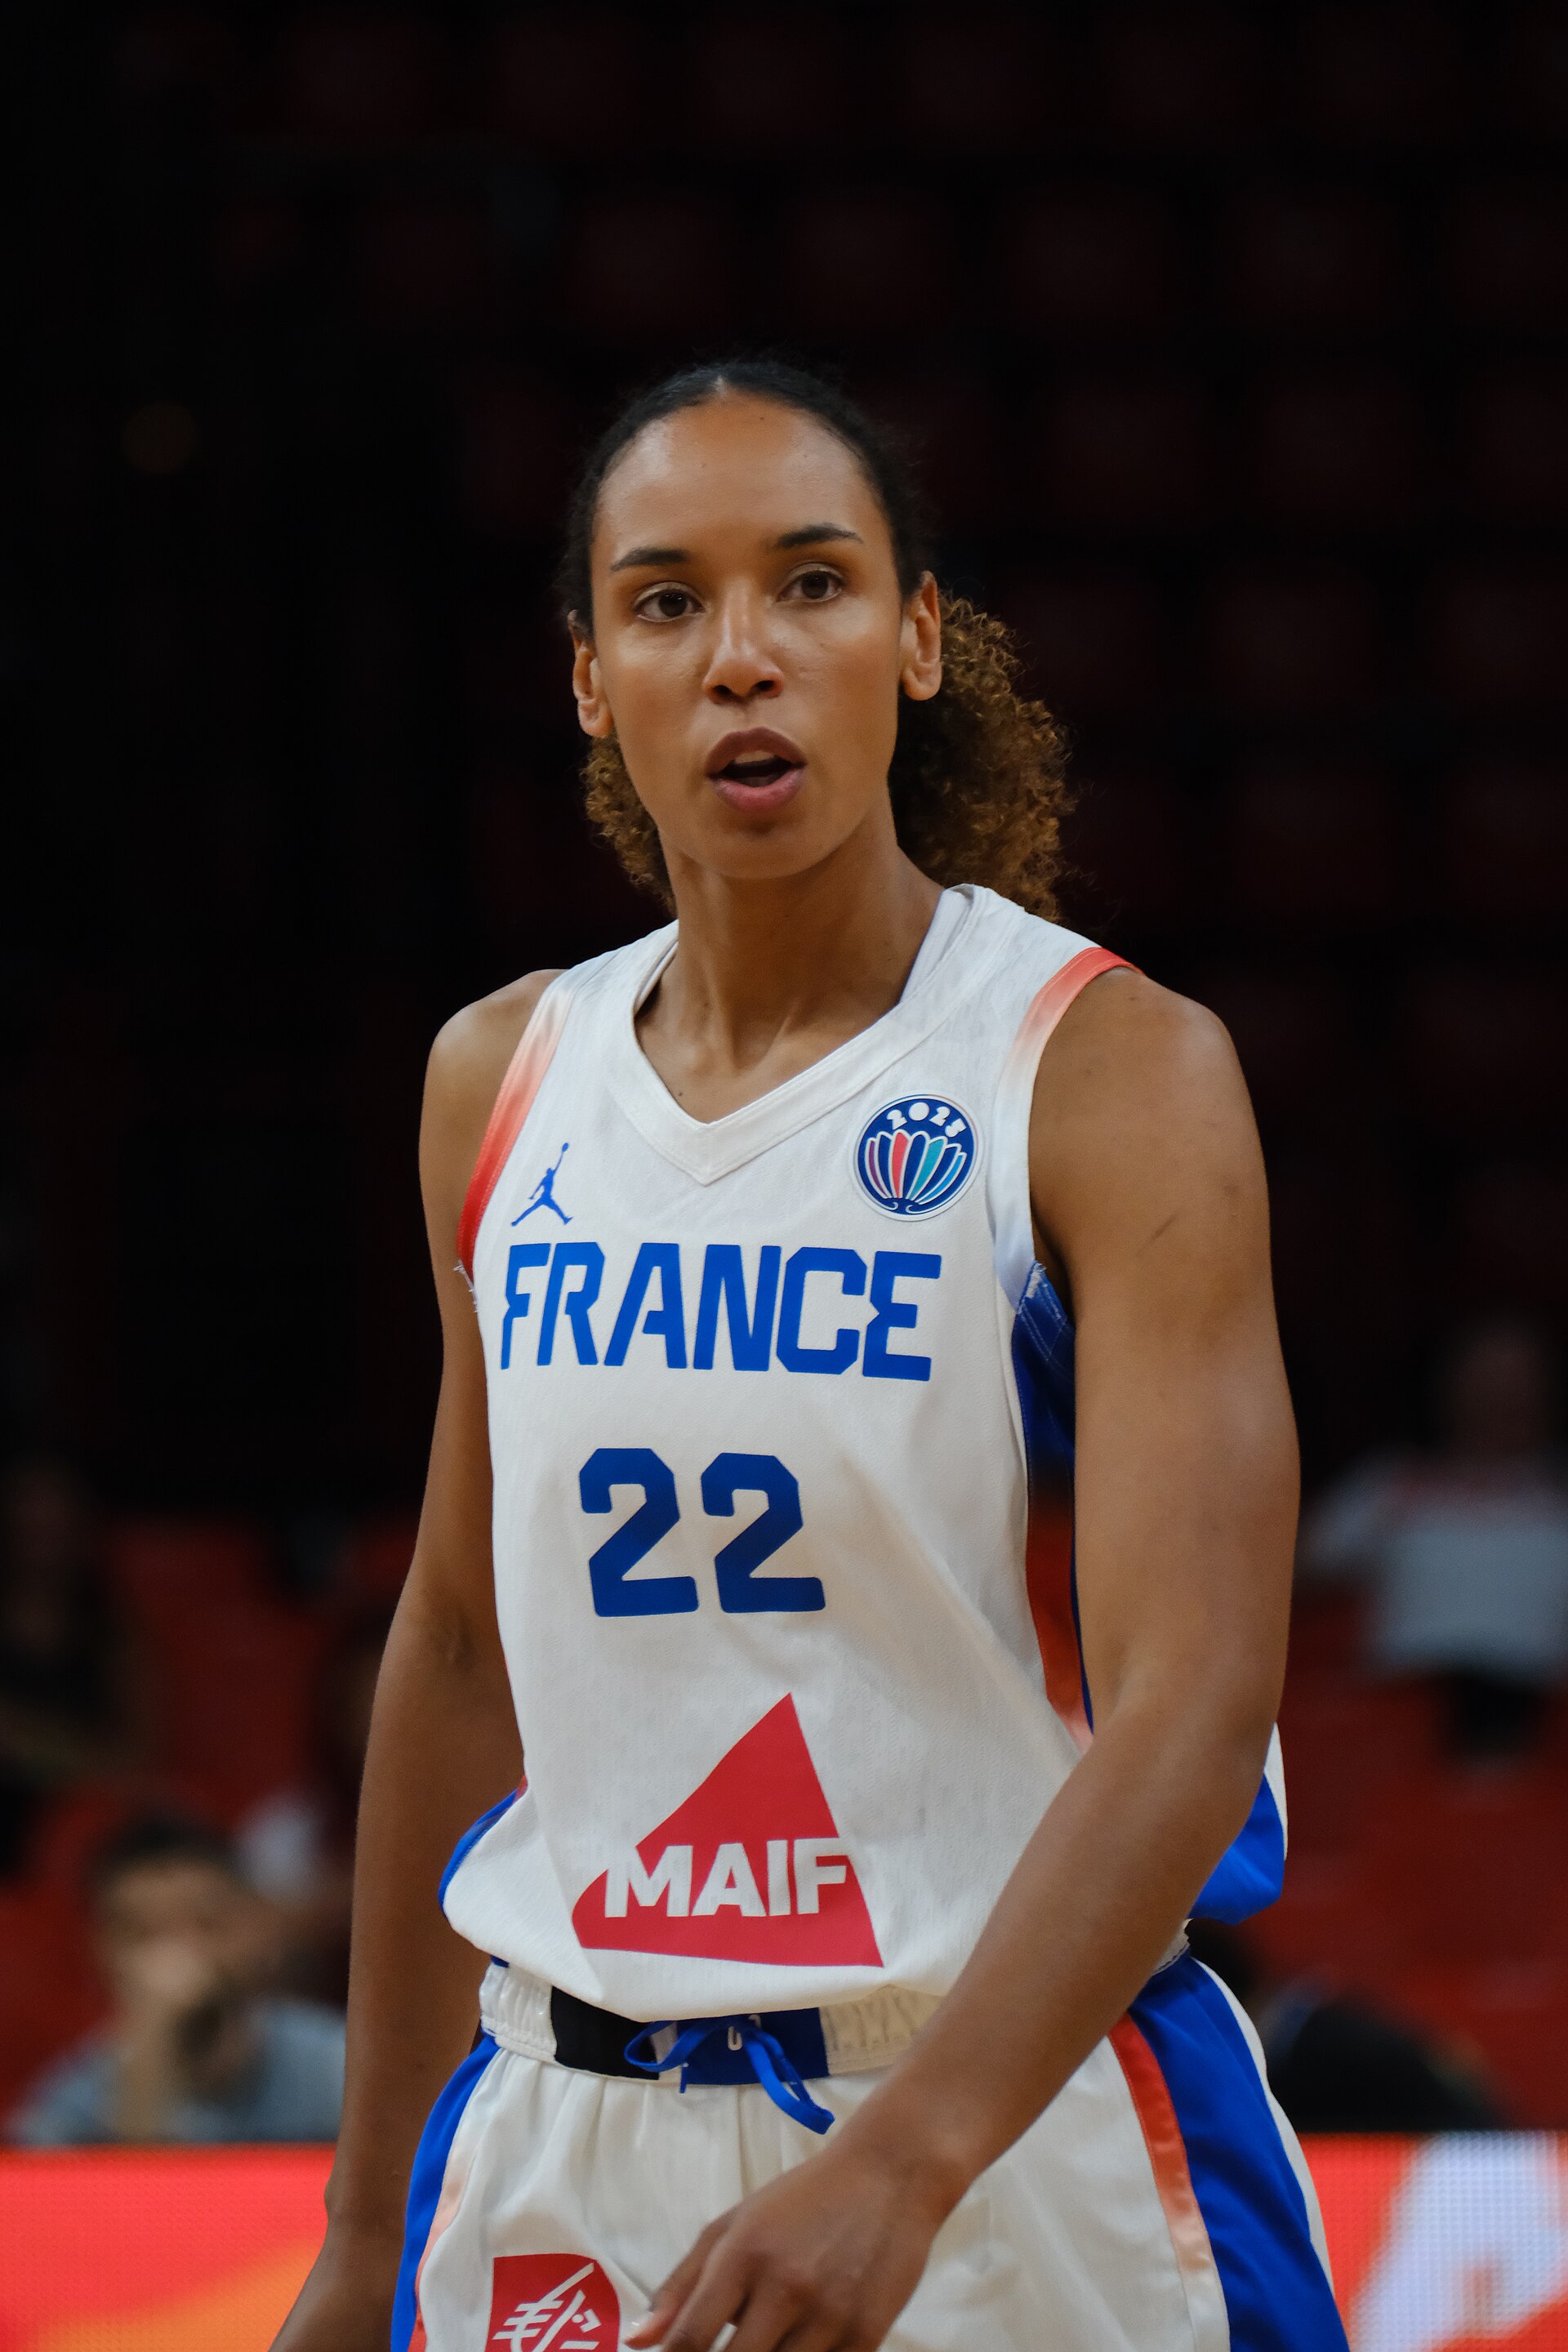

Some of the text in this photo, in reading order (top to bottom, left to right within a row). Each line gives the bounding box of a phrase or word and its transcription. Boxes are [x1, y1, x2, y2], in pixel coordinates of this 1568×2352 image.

[886, 1102, 967, 1138] 2025
[501, 1242, 942, 1382] FRANCE
[579, 1448, 826, 1617] 22
[604, 1838, 848, 1918] MAIF
